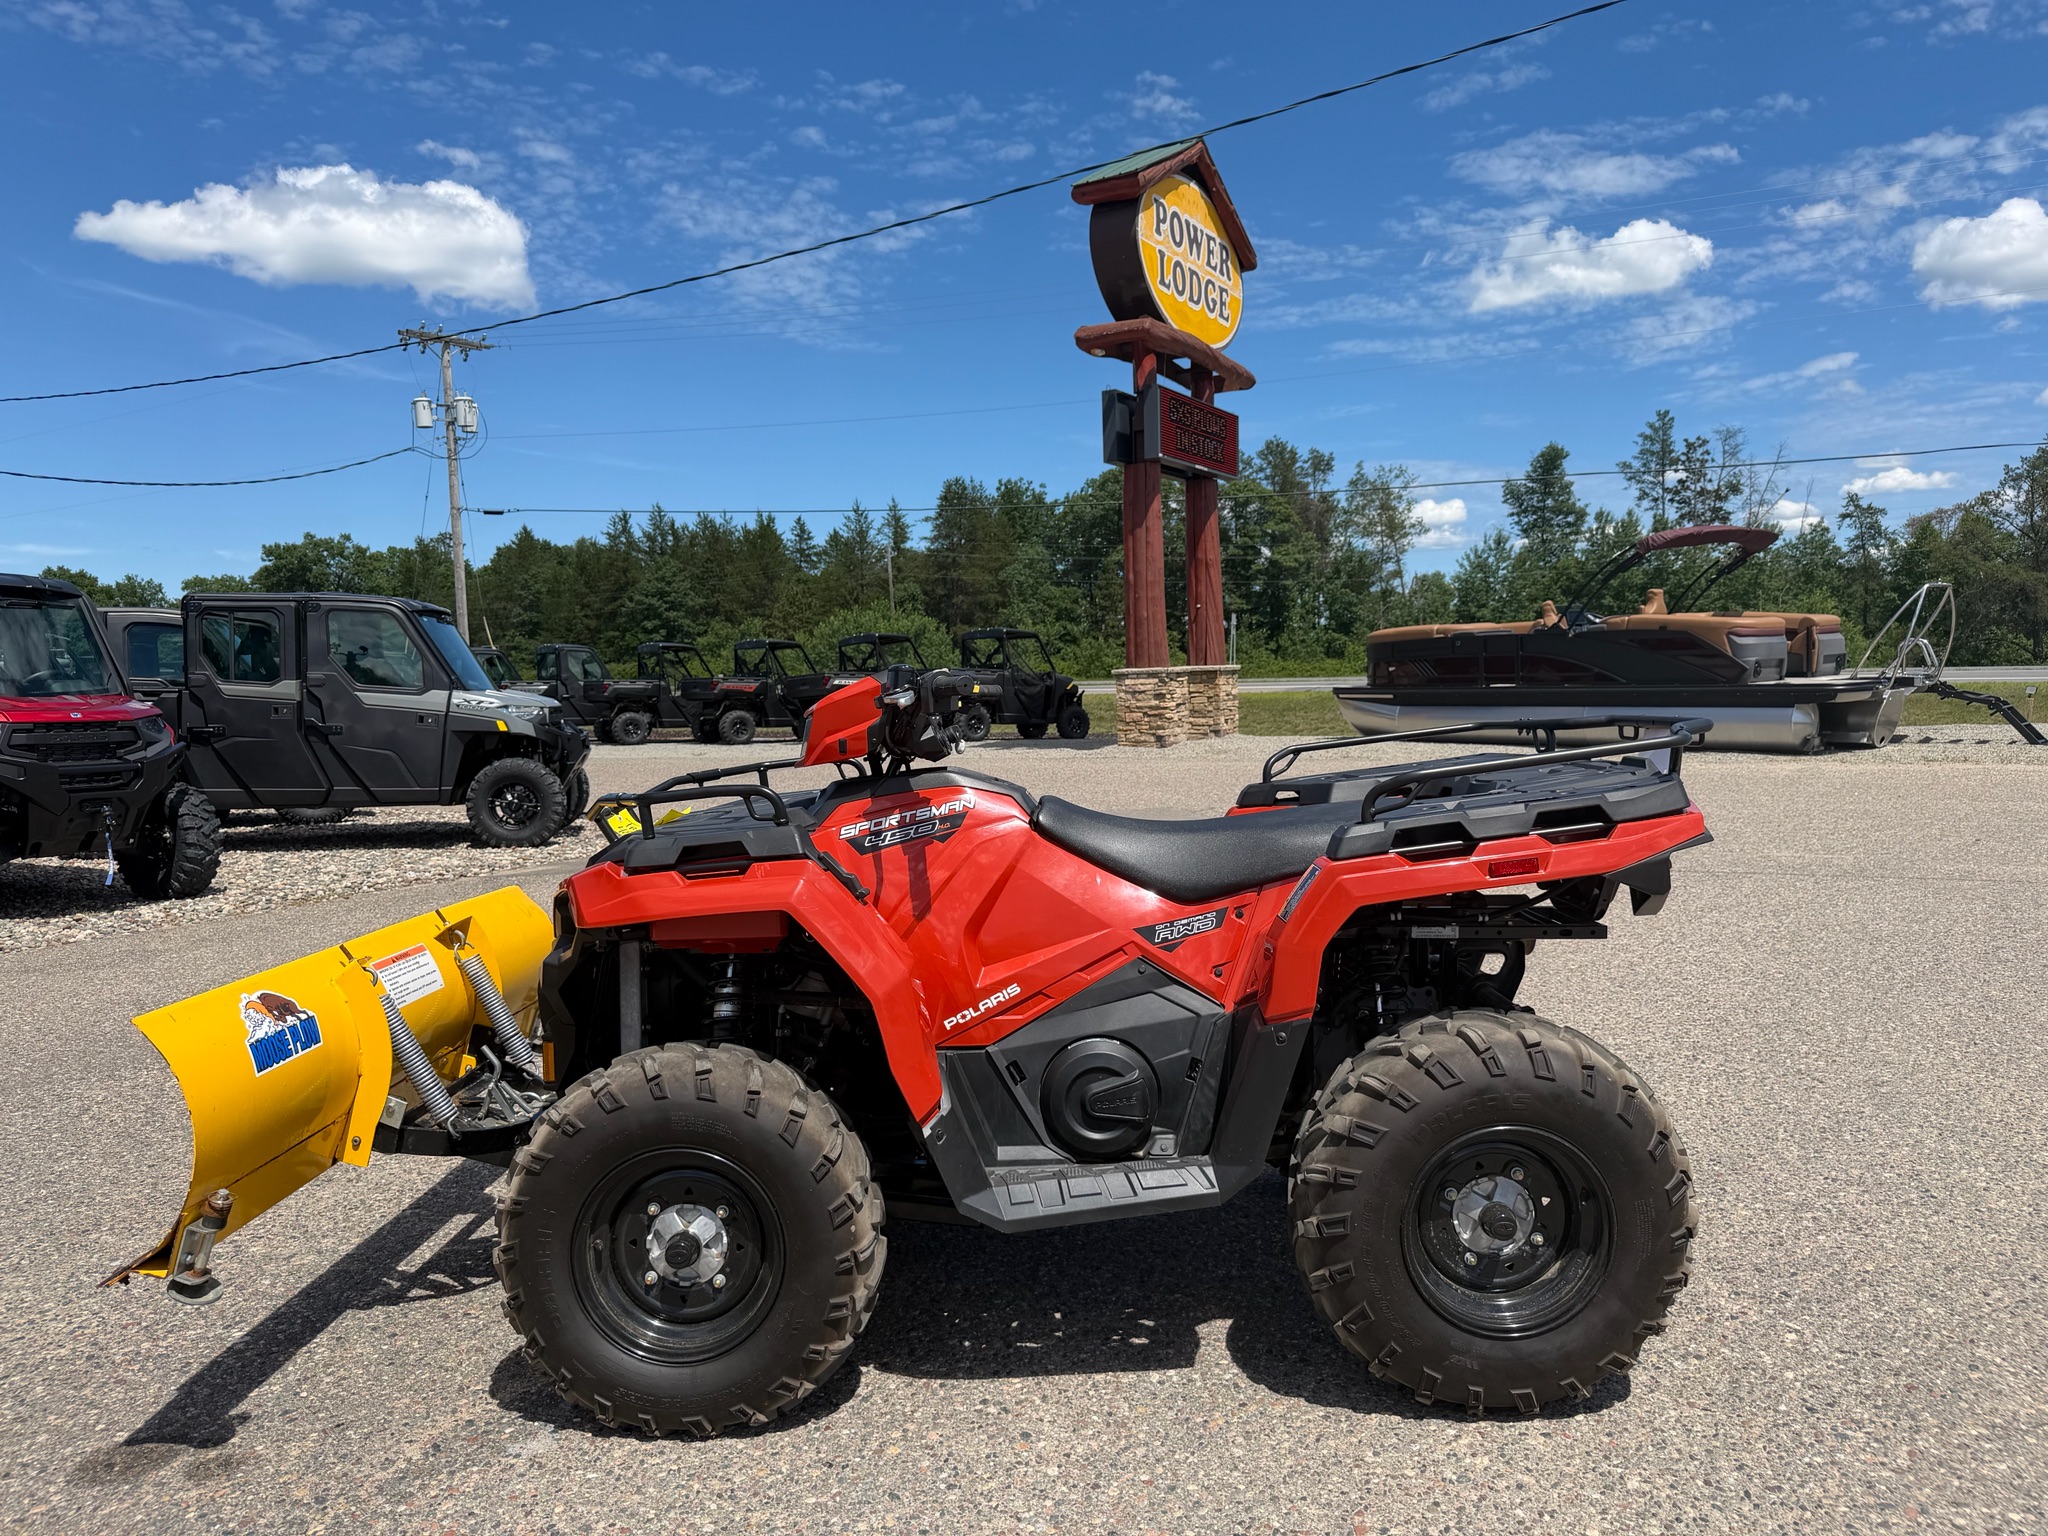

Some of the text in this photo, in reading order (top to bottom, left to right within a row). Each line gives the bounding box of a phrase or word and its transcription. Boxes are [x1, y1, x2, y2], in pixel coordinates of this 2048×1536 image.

[1153, 196, 1232, 282] POWER
[1157, 248, 1230, 323] LODGE
[1176, 428, 1224, 462] IN STOCK
[839, 795, 977, 840] SPORTSMAN
[864, 819, 939, 847] 450
[1154, 917, 1217, 943] AWD
[943, 983, 1021, 1031] POLARIS
[249, 1015, 322, 1074] MOOSE PLOW
[1095, 1097, 1138, 1109] POLARIS
